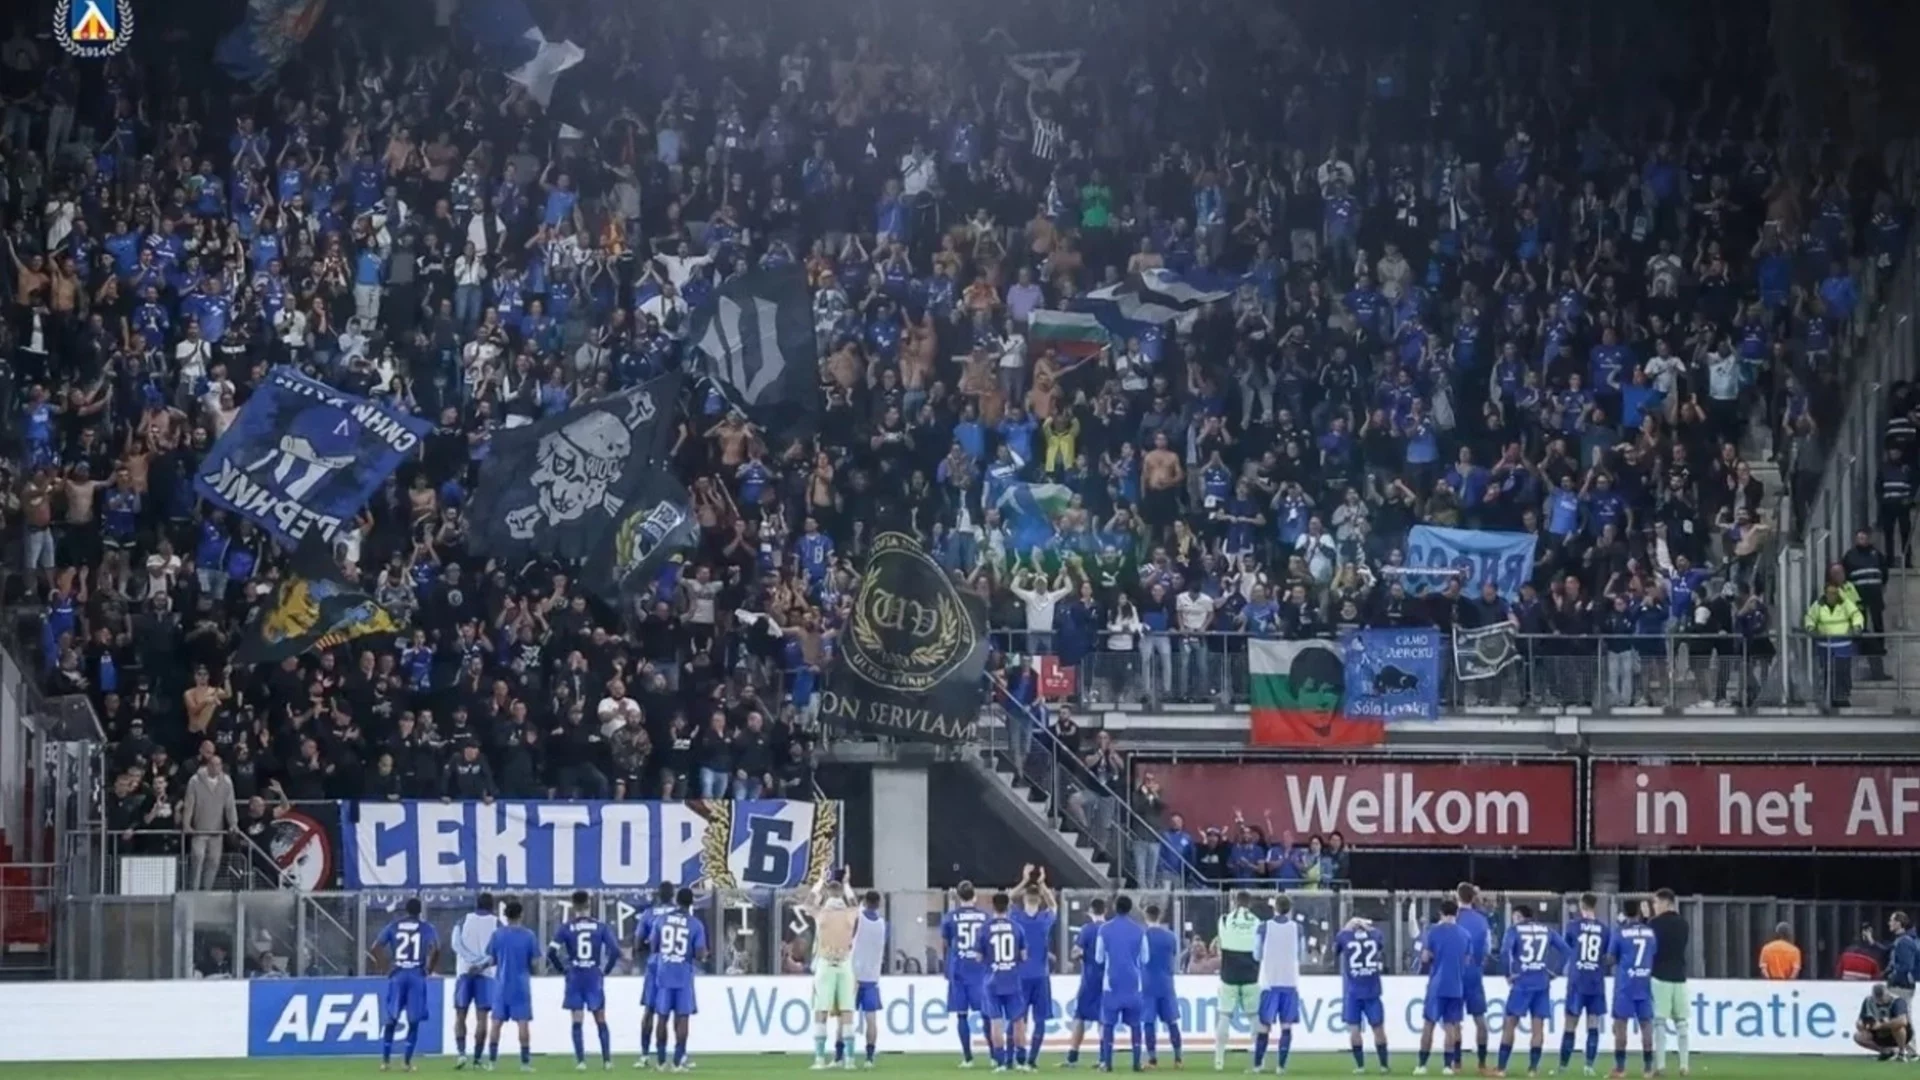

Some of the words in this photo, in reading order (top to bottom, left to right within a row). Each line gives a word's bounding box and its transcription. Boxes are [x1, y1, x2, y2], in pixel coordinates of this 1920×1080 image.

[822, 691, 861, 719] ON
[1286, 773, 1529, 835] Welkom
[1636, 773, 1687, 835] in
[1719, 773, 1813, 835] het
[357, 803, 706, 886] СЕКТОР
[744, 815, 793, 886] Б
[394, 932, 420, 960] 21
[577, 933, 592, 959] 6
[660, 927, 690, 956] 95
[990, 933, 1015, 962] 10
[1347, 940, 1378, 968] 22
[1519, 934, 1548, 962] 37
[1578, 933, 1602, 962] 18
[1633, 938, 1647, 967] 7
[726, 983, 864, 1036] Wo
[886, 983, 949, 1036] de
